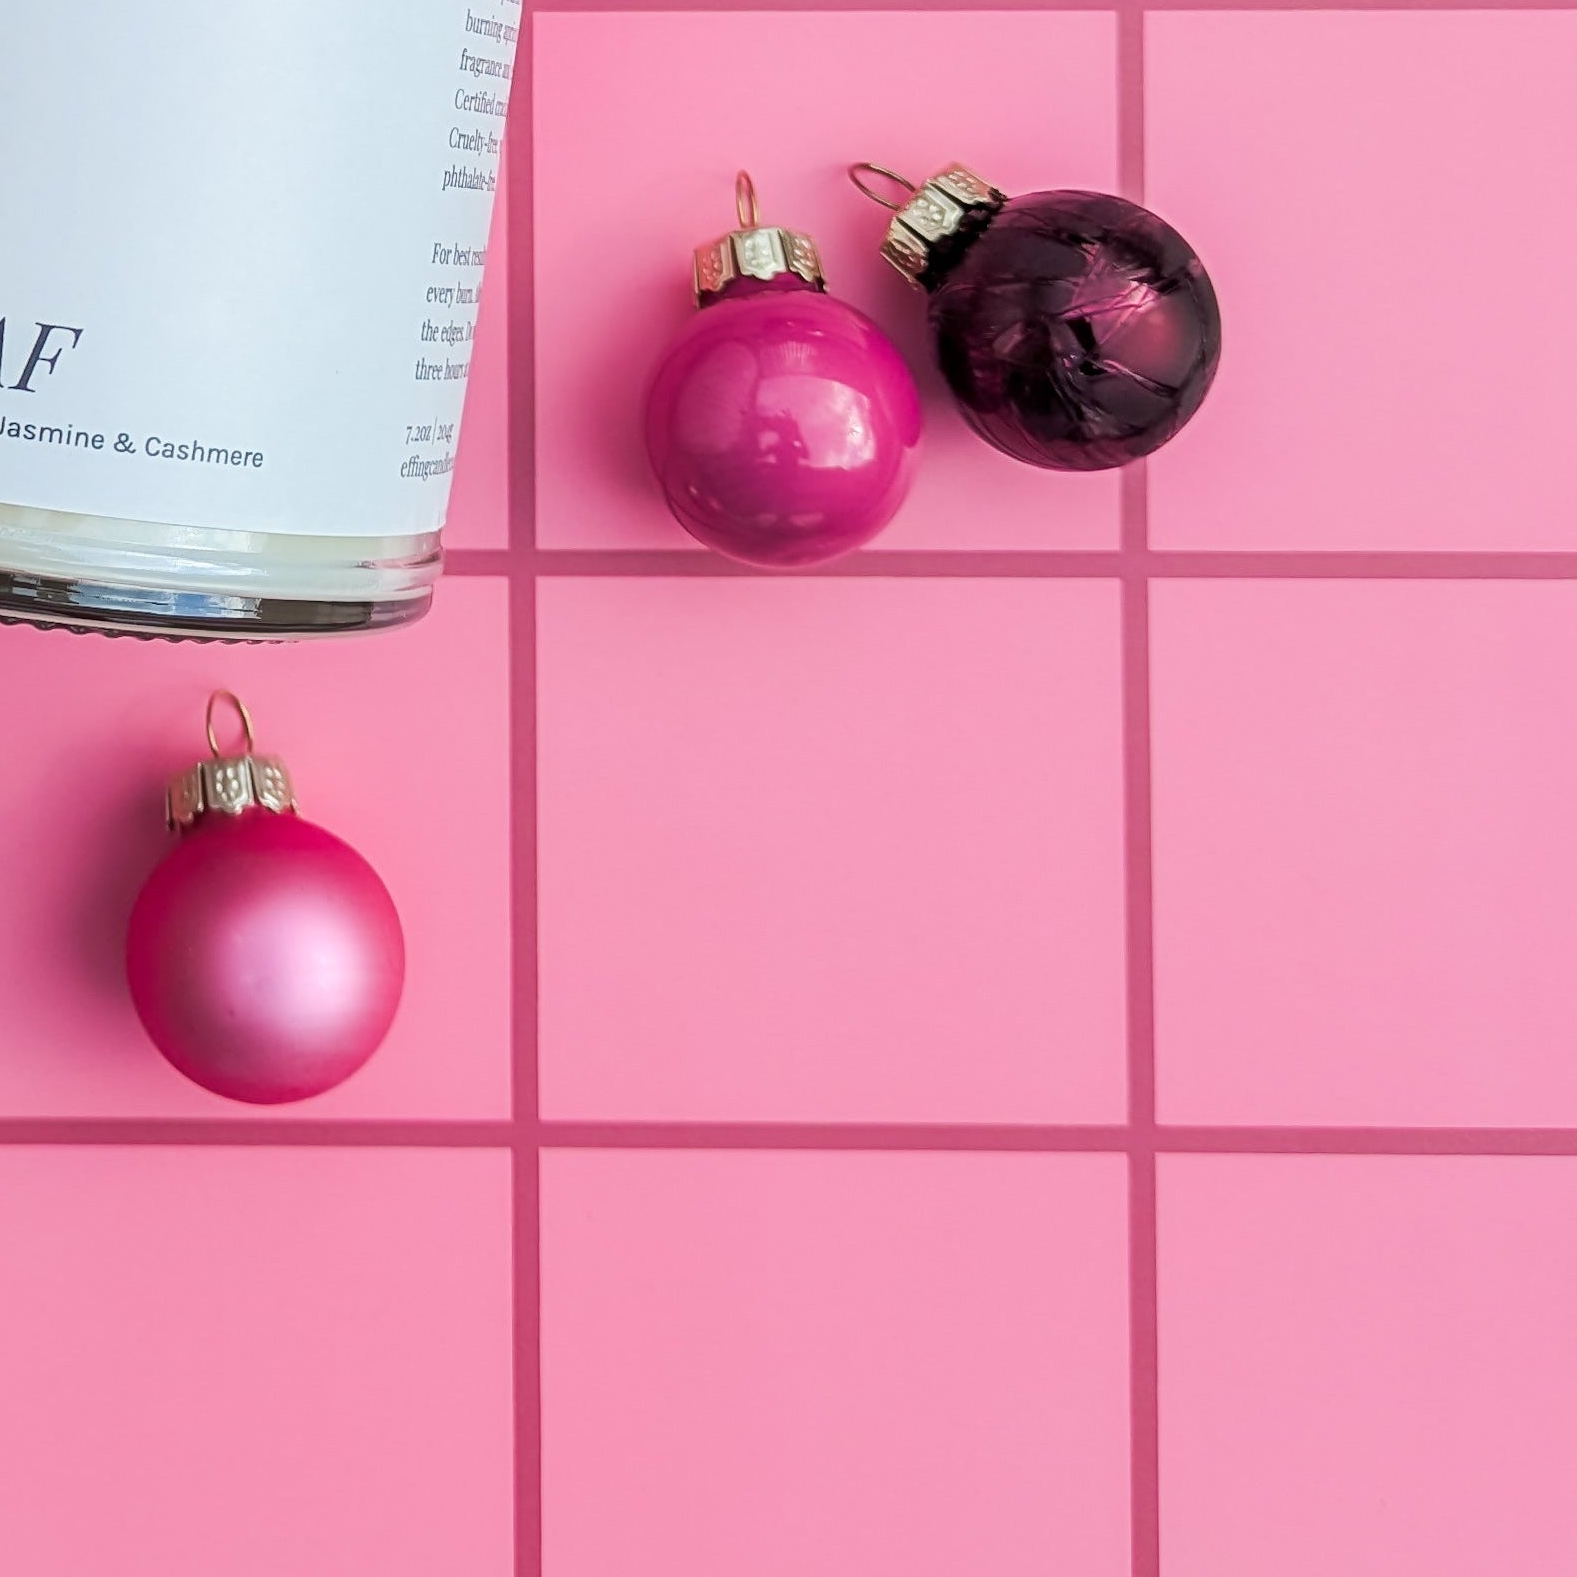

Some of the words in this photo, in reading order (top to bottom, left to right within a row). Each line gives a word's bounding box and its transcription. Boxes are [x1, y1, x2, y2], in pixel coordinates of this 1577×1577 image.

[465, 8, 502, 44] burning
[459, 48, 502, 78] fragrance
[455, 88, 496, 115] Certified
[432, 242, 452, 265] For
[453, 242, 471, 266] best
[426, 284, 455, 308] every
[421, 319, 439, 342] the
[415, 357, 443, 380] three
[113, 432, 136, 454] &
[144, 436, 265, 470] Cashmere
